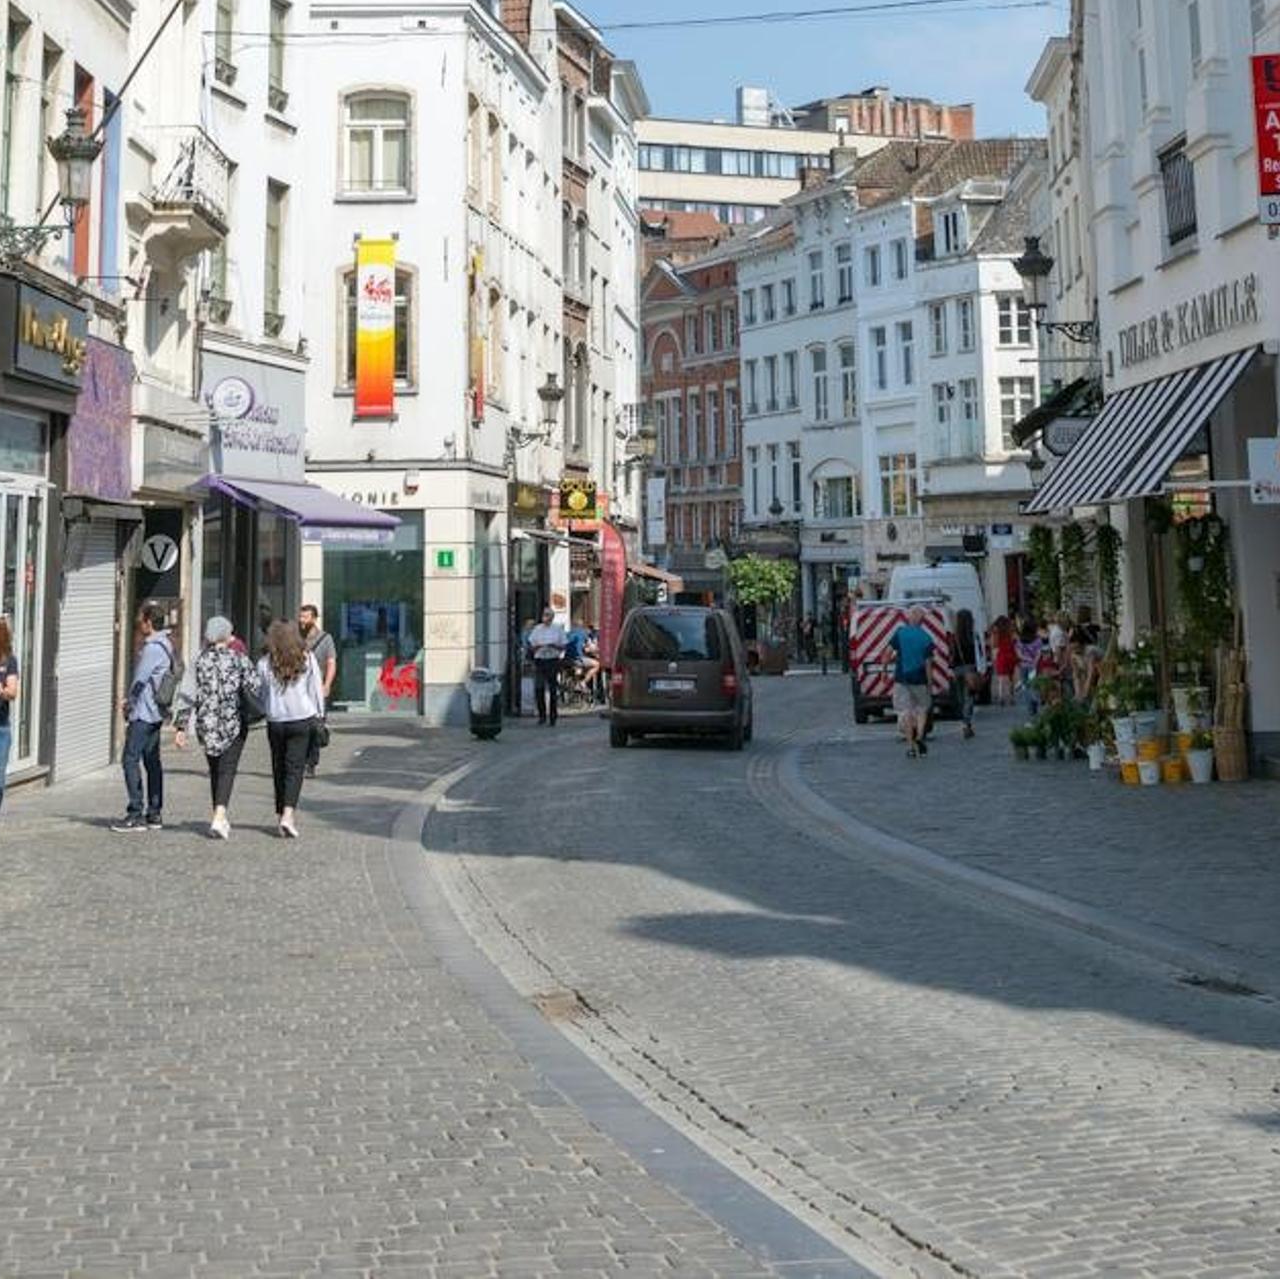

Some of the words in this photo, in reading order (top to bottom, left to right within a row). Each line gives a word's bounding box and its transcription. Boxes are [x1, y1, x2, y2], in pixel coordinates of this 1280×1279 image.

[1265, 111, 1280, 130] A
[1161, 310, 1174, 354] &
[1176, 271, 1260, 349] KAMILLE
[149, 543, 170, 569] V
